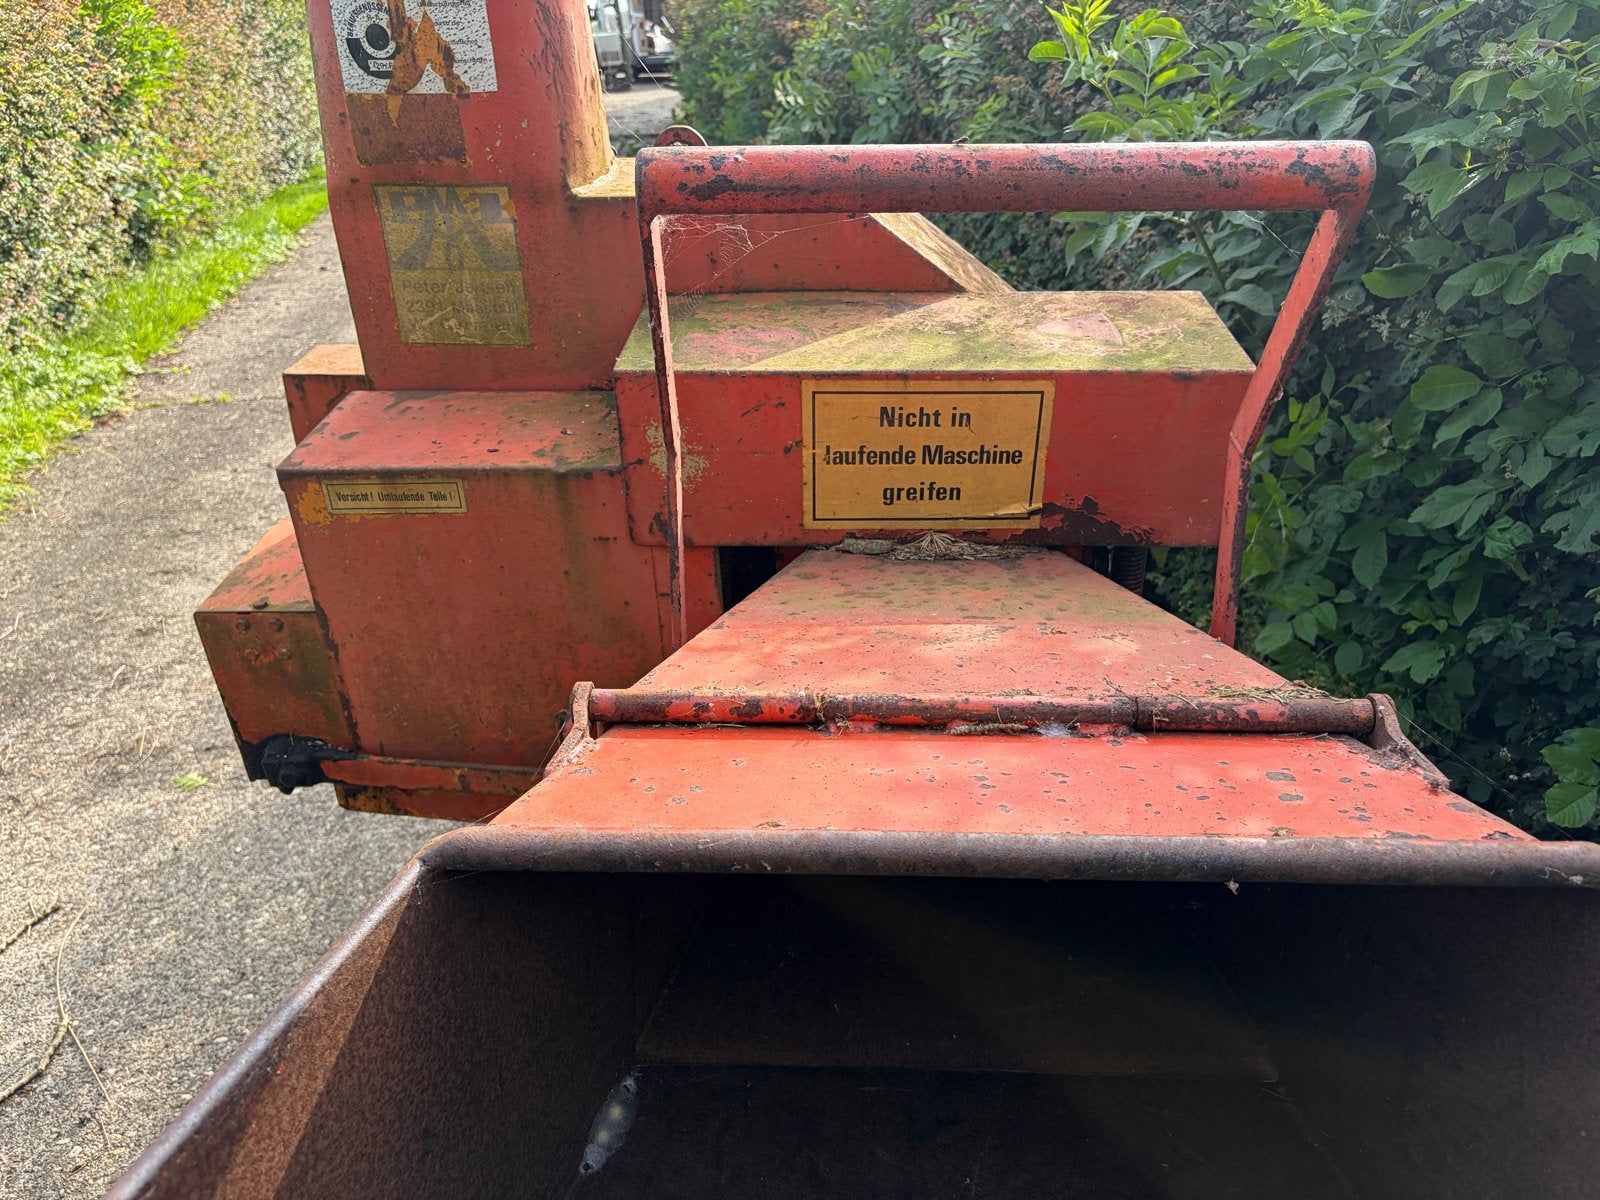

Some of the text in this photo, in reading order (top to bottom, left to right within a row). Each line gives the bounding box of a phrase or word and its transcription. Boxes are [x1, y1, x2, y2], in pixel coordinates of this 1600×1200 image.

[401, 279, 446, 294] Peter
[405, 299, 442, 313] 2391
[879, 406, 972, 428] Nicht in
[825, 444, 1024, 466] laufende Maschine
[377, 491, 425, 502] Umlaufende
[882, 481, 962, 506] greifen
